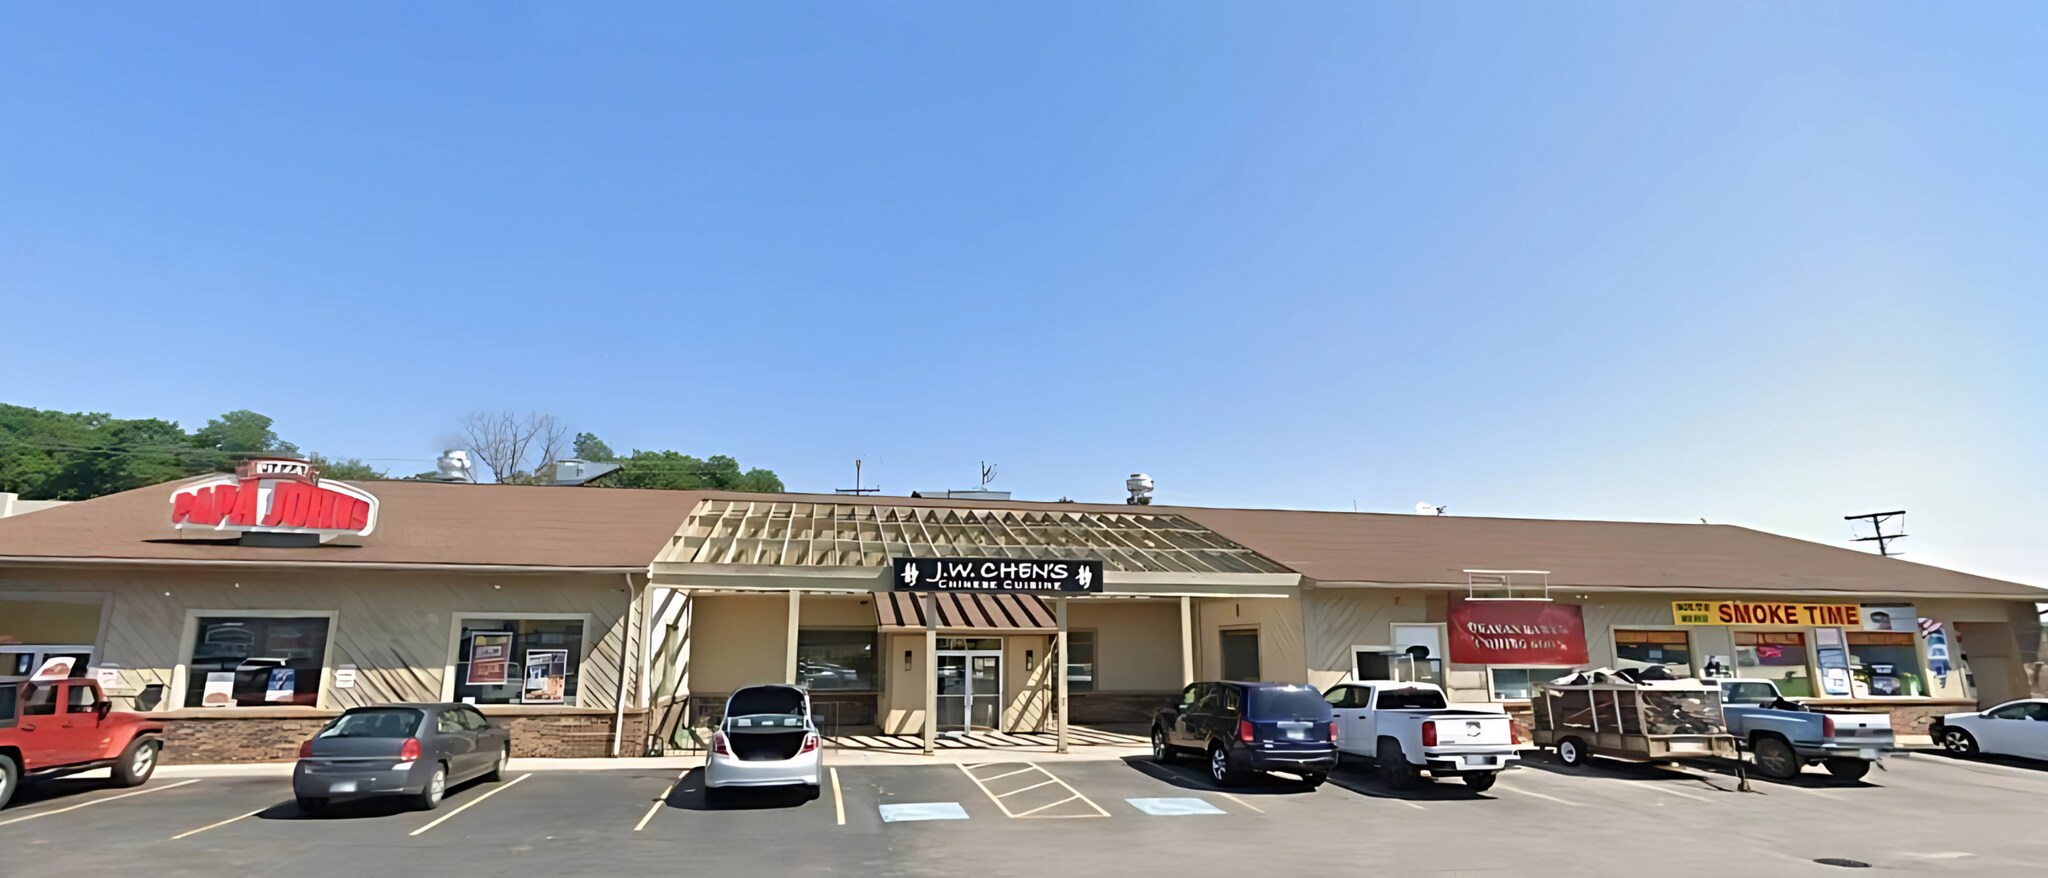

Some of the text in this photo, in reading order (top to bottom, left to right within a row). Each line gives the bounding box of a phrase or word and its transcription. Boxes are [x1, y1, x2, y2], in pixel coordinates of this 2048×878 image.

[172, 479, 259, 526] PAPA
[926, 562, 1068, 582] J.W. CHEN'S
[1718, 604, 1799, 624] SMOKE
[1803, 606, 1860, 625] TIME
